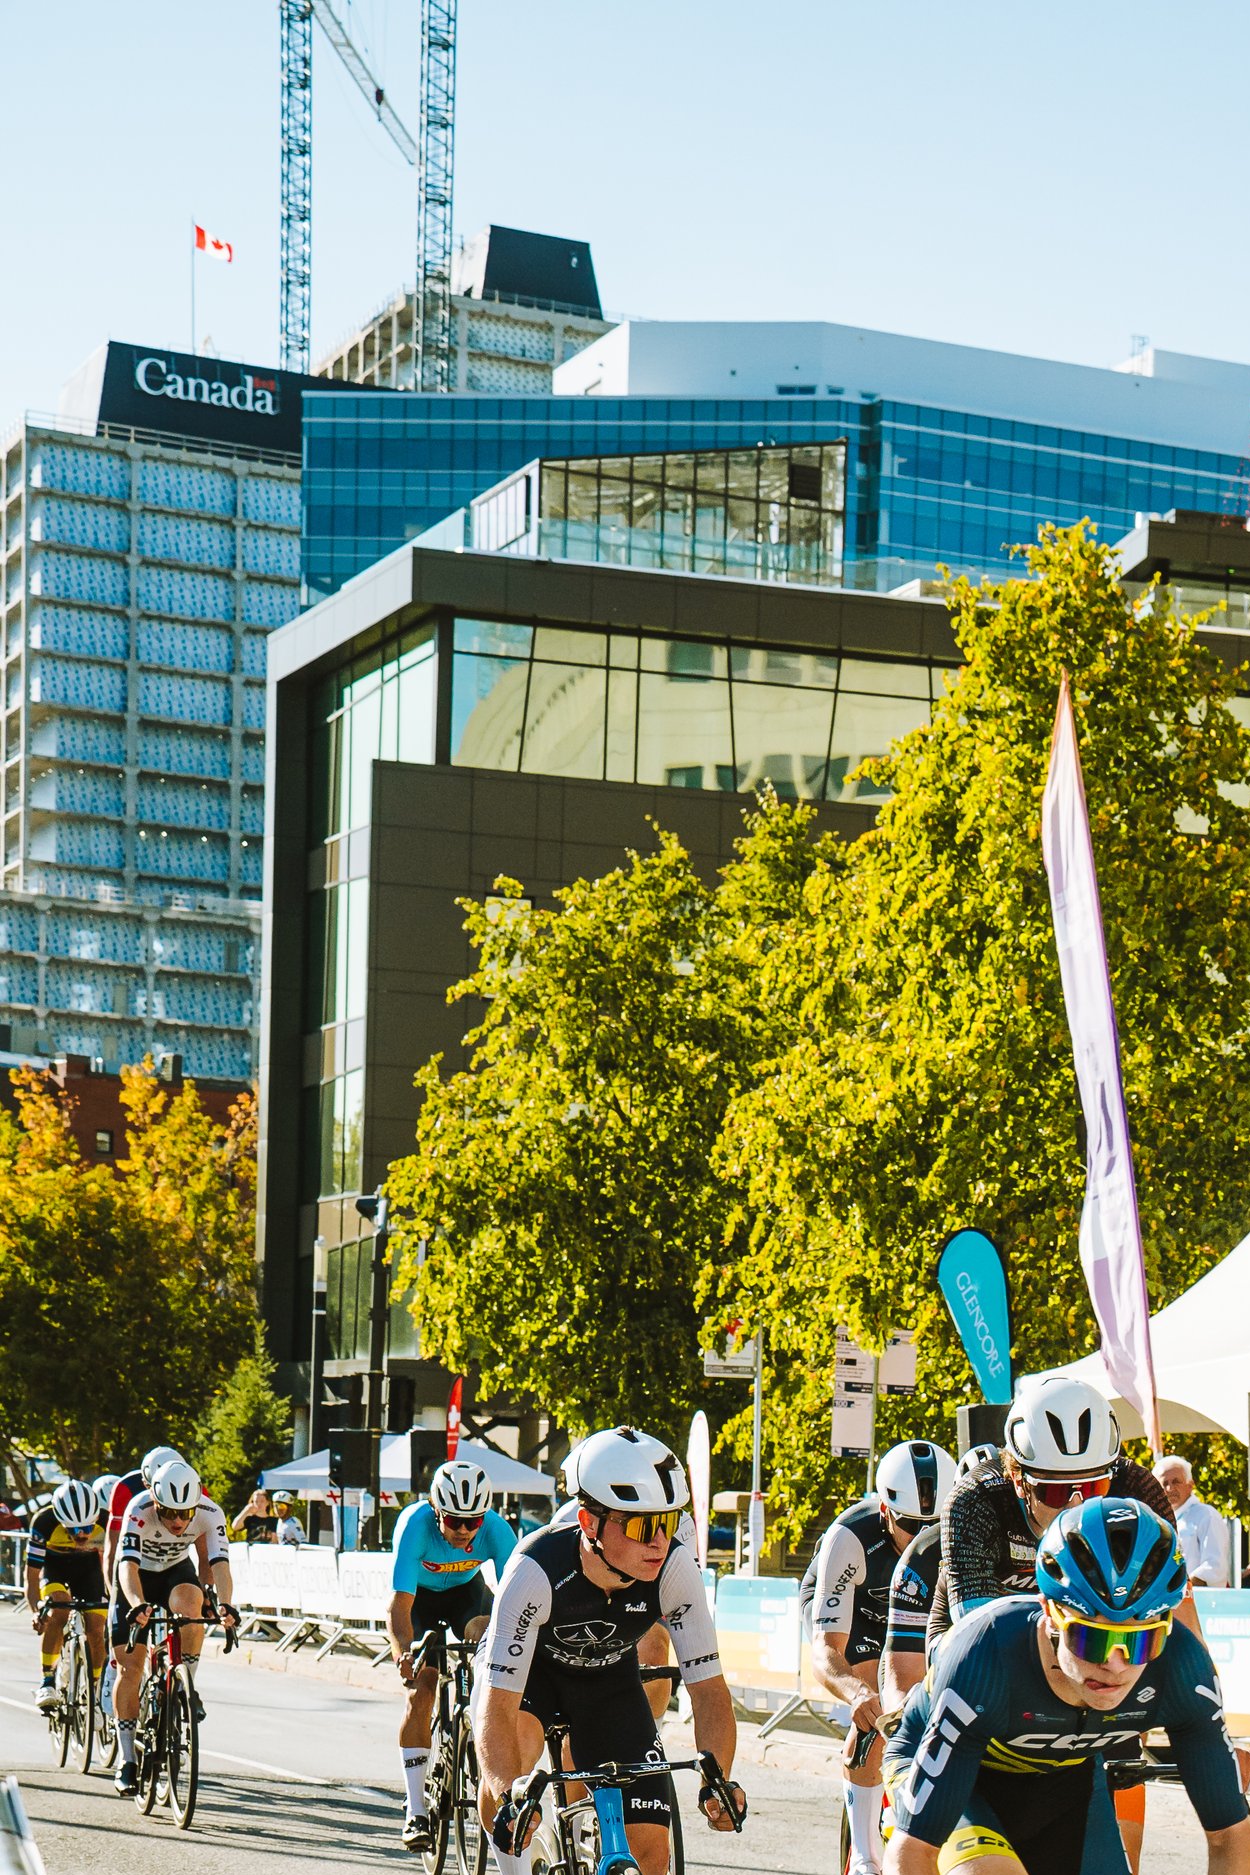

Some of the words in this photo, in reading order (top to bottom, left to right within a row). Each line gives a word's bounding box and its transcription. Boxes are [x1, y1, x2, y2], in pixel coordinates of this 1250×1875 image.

[135, 357, 277, 415] Canada
[956, 1271, 1005, 1378] GLENCORE
[514, 1602, 539, 1642] ROGERS
[462, 1668, 470, 1697] BMC
[486, 1663, 519, 1675] EK
